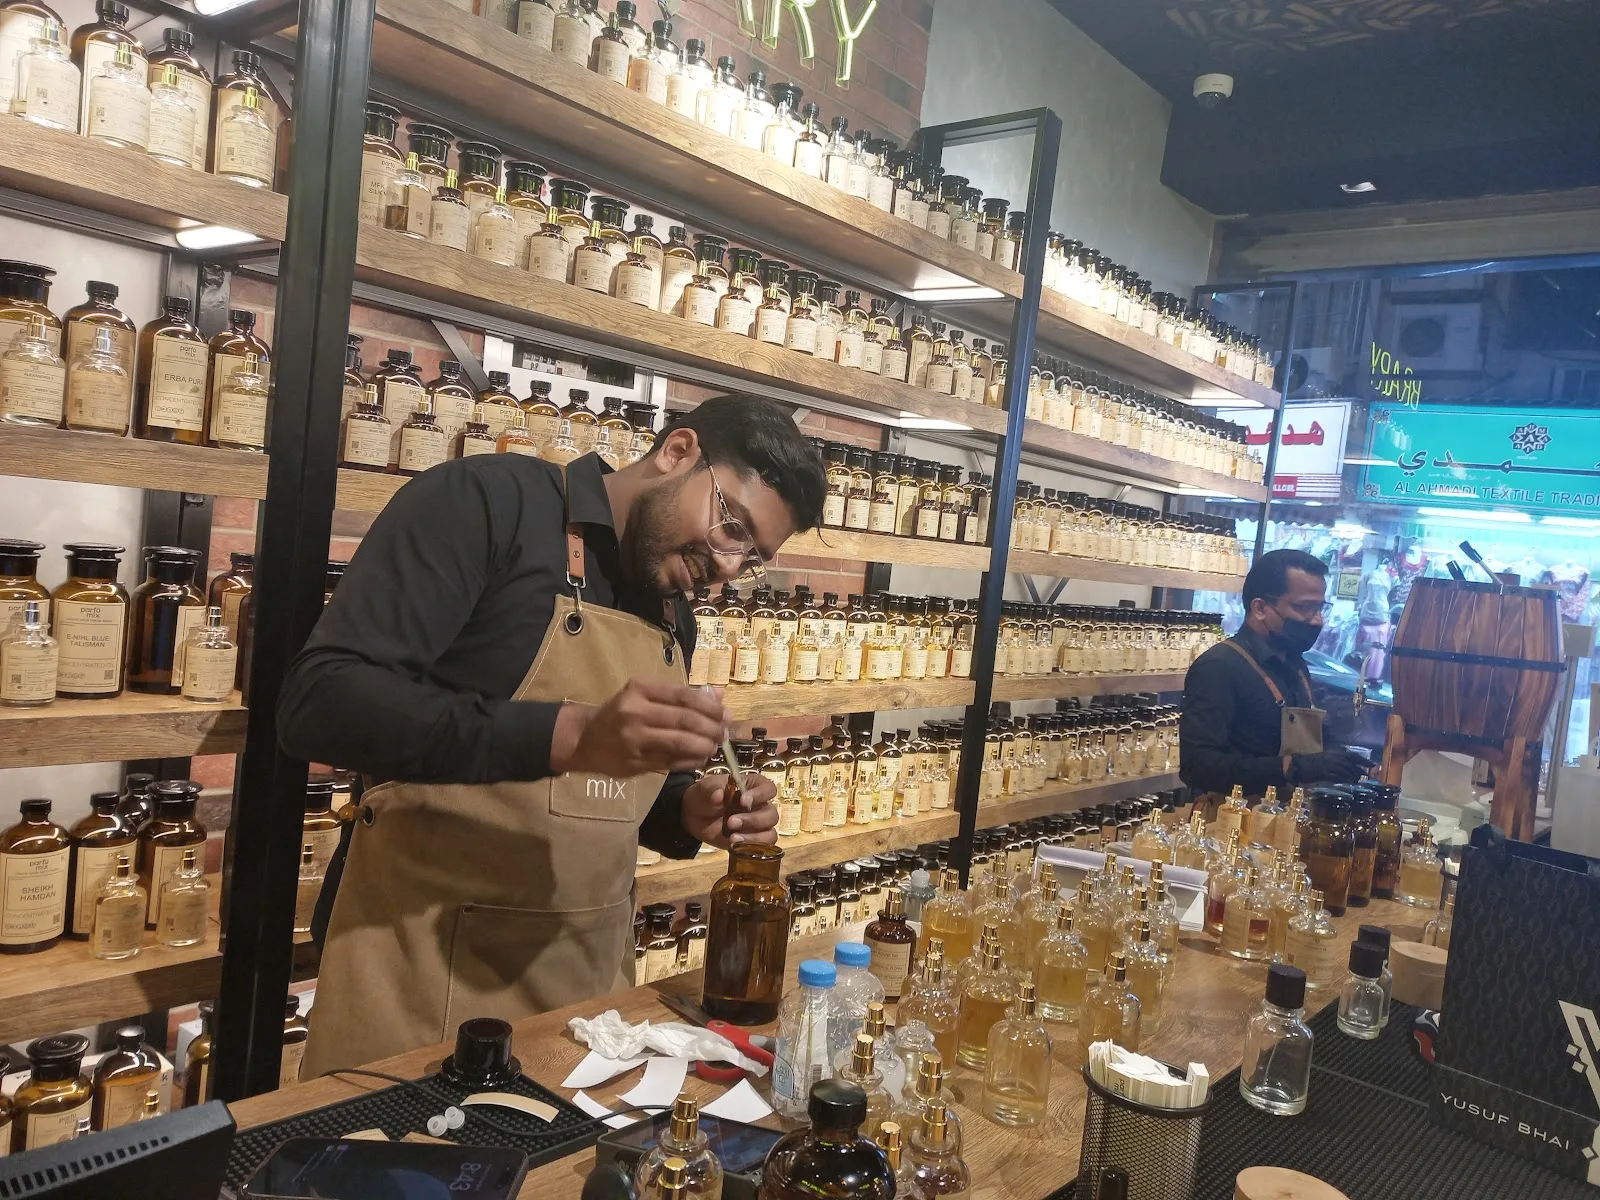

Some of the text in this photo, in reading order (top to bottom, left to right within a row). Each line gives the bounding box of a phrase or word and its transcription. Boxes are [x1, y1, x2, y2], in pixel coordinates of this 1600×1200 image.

[164, 373, 187, 384] ERBA
[1394, 481, 1412, 494] AL
[1416, 483, 1478, 498] AHMADI
[1481, 486, 1545, 502] TEXTILE
[69, 640, 106, 648] TALISMAN
[586, 777, 626, 799] mix
[21, 884, 54, 894] SHEIKH
[20, 891, 56, 901] HAMDAN
[1441, 1092, 1570, 1151] YUSUF BHAI
